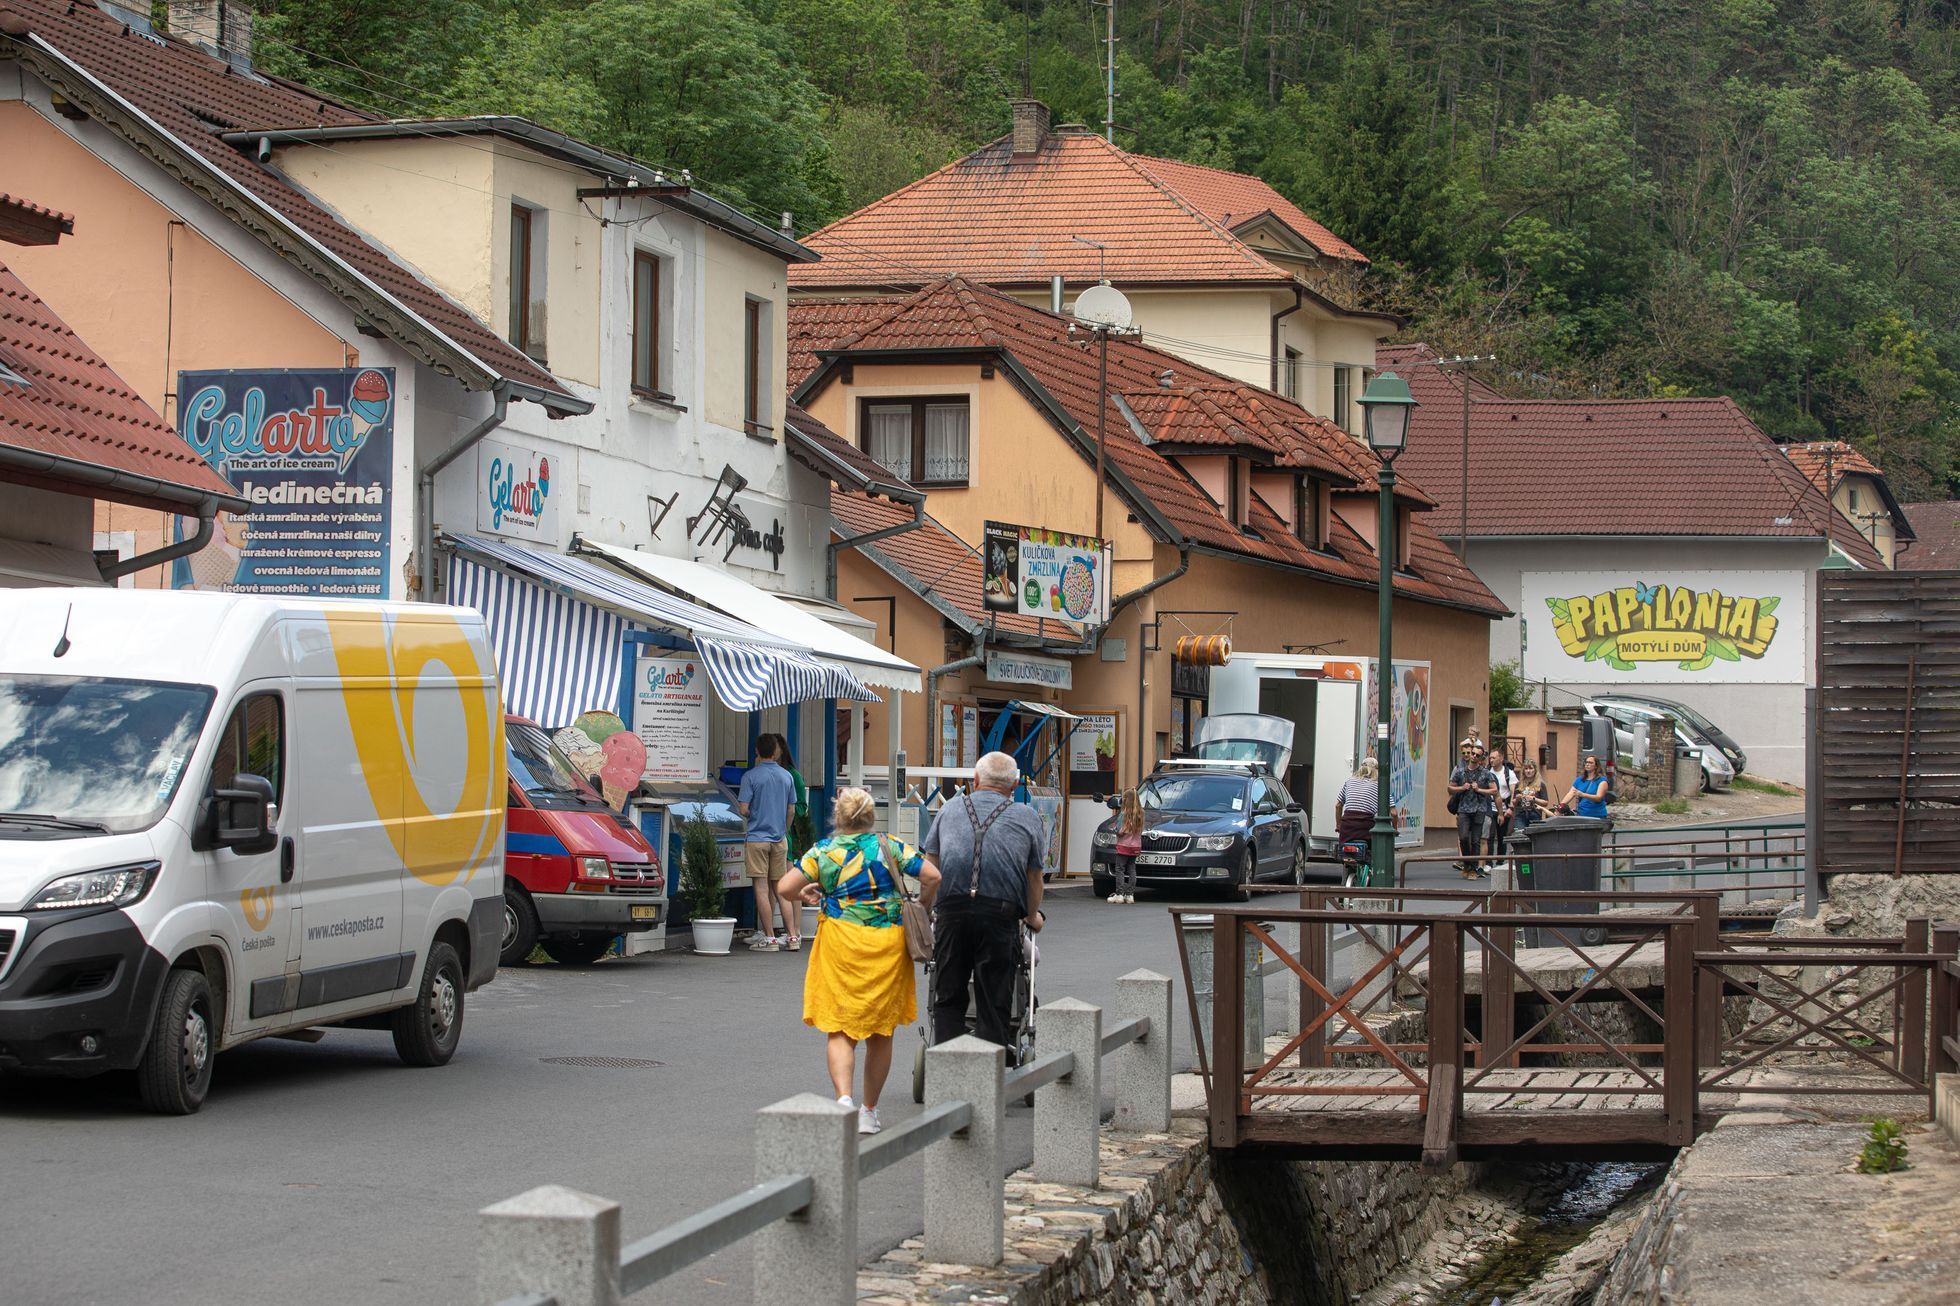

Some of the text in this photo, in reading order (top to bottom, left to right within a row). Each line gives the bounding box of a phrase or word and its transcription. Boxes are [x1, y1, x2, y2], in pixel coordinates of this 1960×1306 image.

[187, 387, 364, 470] Gelarto
[230, 458, 334, 468] The art of ice cream
[242, 481, 383, 504] Jedinečná
[489, 457, 543, 530] Gelarto
[266, 512, 310, 522] zmrzlina
[311, 512, 330, 522] zde
[331, 513, 382, 524] výraběná
[241, 531, 278, 540] točená
[279, 531, 323, 540] zmrzlina
[331, 531, 353, 540] naší
[354, 531, 381, 542] dílny
[986, 527, 1003, 536] BLACK
[1003, 530, 1018, 538] MAGIC
[240, 548, 381, 560] mražené krémové espresso
[254, 566, 381, 576] ovocná ledová limonáda
[1028, 561, 1061, 577] ZMRZLINA
[222, 584, 259, 593] ledové
[260, 584, 309, 593] smoothie
[319, 585, 356, 594] ledová
[1621, 639, 1701, 653] MOTÝLÍ DŮM
[647, 665, 689, 692] Gelarto
[663, 693, 704, 701] ARTIGIANALE
[1154, 855, 1173, 864] 2770
[308, 916, 384, 940] www.ceskaposta.cz
[241, 935, 276, 951] Česká pošta
